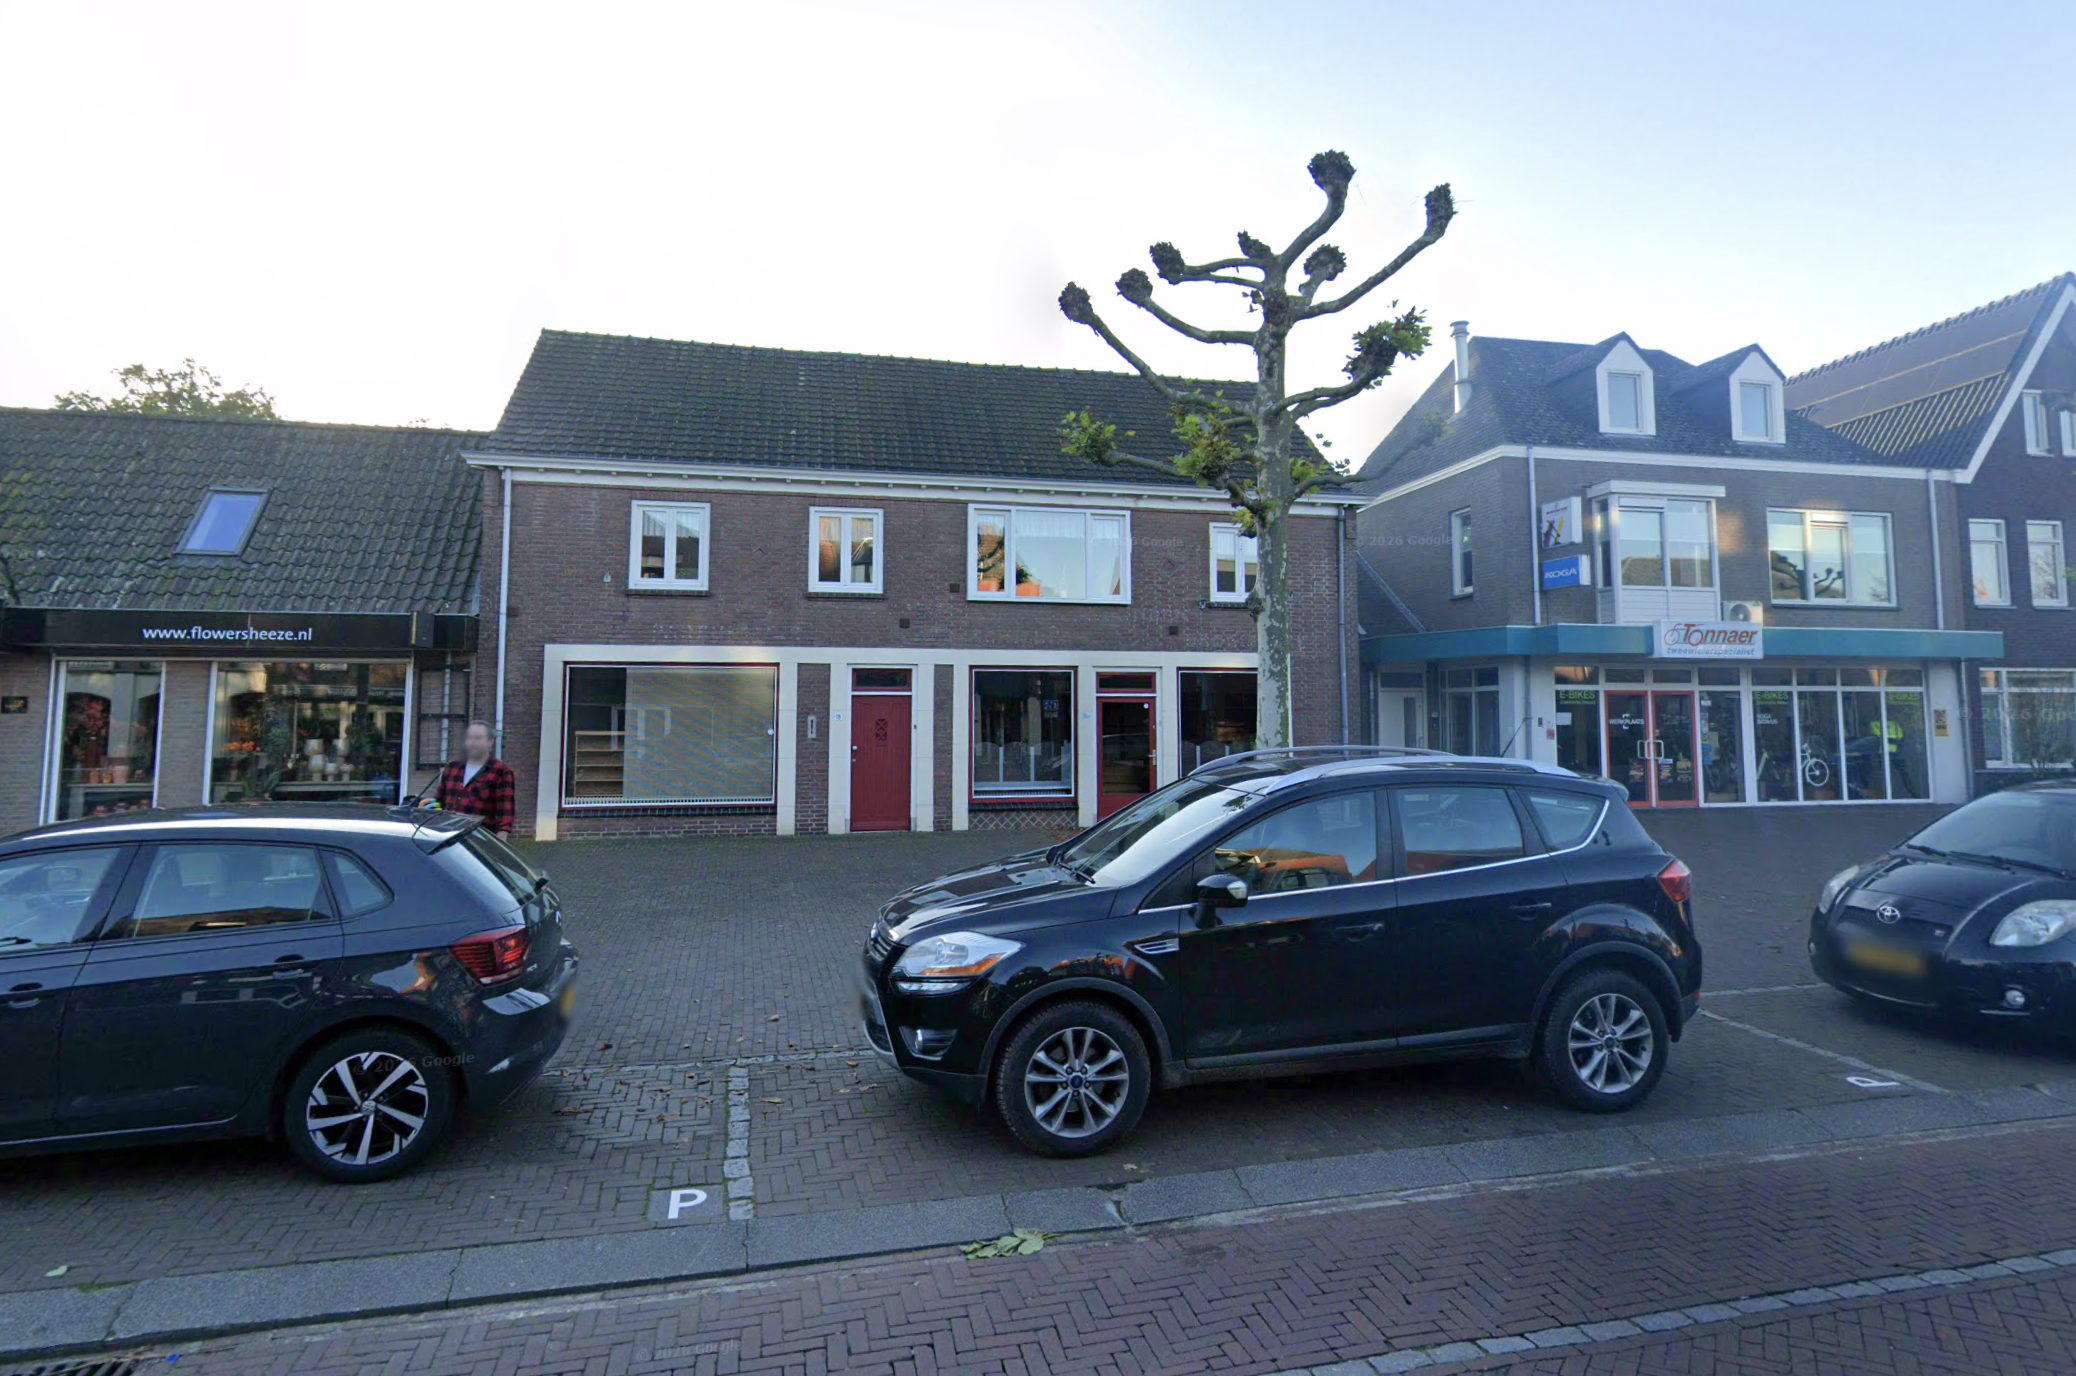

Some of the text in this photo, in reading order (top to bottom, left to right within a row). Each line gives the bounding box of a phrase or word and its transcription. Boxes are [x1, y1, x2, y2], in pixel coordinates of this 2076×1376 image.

[1545, 567, 1578, 579] KOGA
[142, 625, 313, 641] www.flowersheeze.nl
[1682, 623, 1758, 647] Tonnaer
[1559, 690, 1596, 700] E-BIKES
[667, 1189, 708, 1219] P
